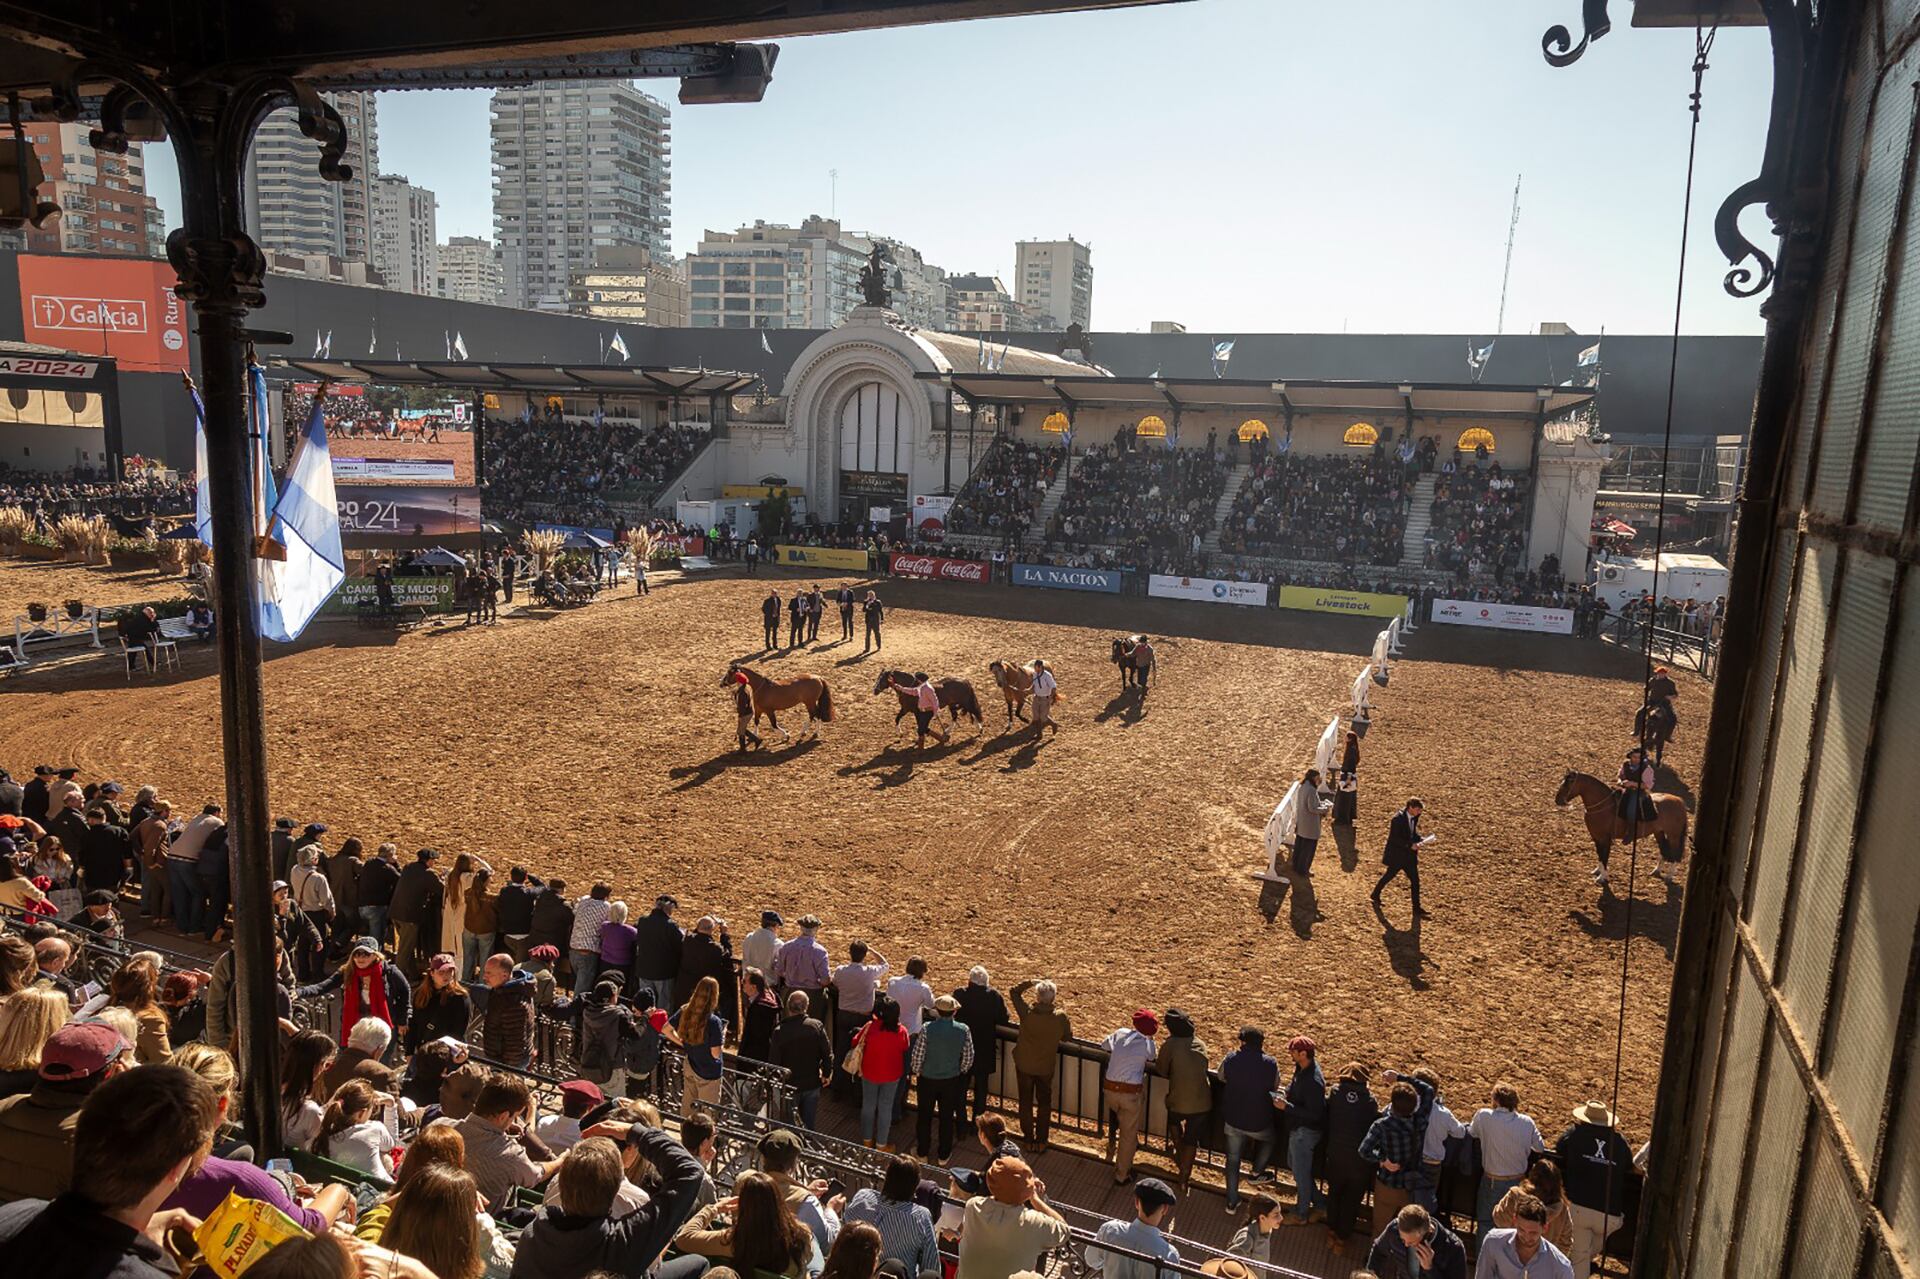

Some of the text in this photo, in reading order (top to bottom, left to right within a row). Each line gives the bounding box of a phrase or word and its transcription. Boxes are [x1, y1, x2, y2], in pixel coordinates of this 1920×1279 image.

[161, 286, 178, 325] Rural
[70, 303, 139, 326] Galicia
[15, 360, 86, 376] 2024
[365, 501, 400, 529] 24
[1024, 569, 1108, 586] LA NACION
[408, 585, 449, 594] MUCHO
[1315, 598, 1370, 610] Livestock
